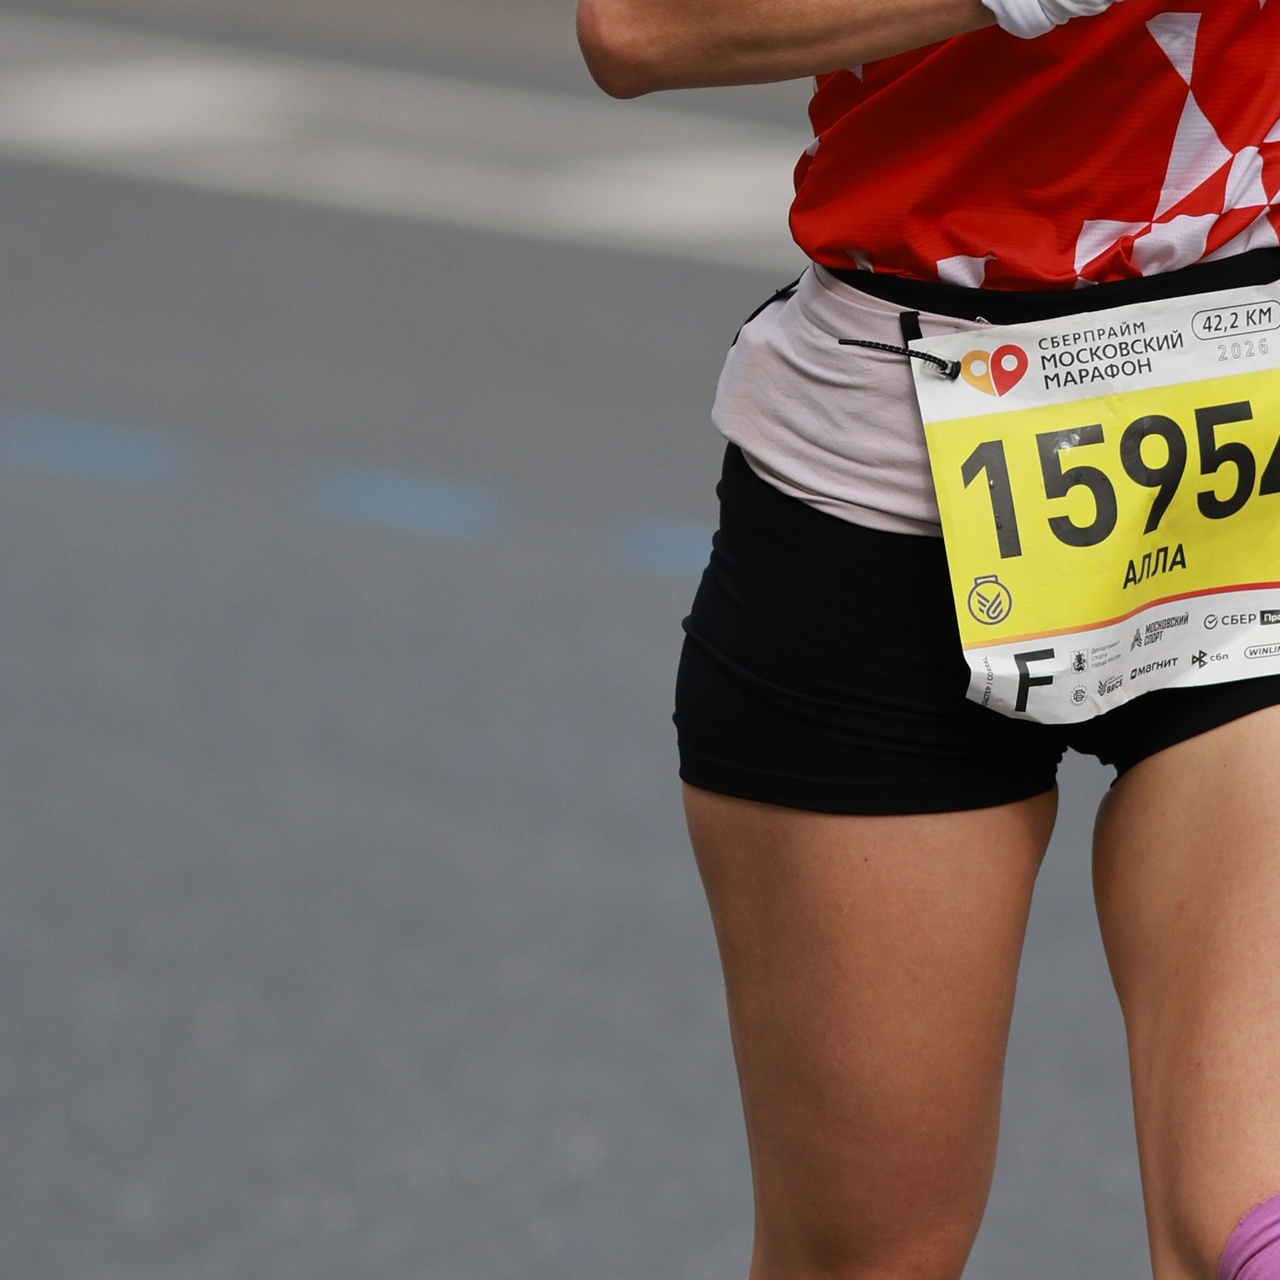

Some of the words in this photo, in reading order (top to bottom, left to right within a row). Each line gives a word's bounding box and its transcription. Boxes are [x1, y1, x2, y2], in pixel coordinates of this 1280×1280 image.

[1201, 311, 1240, 334] 42,2
[1245, 306, 1273, 326] КМ
[1038, 321, 1147, 351] СБЕРПРАЙМ
[1040, 329, 1184, 371] МОСКОВСКИЙ
[1217, 337, 1270, 362] 2026
[1043, 357, 1153, 391] МАРАФОН
[1122, 542, 1188, 590] АЛЛА
[1144, 612, 1190, 634] МОСКОВСКИЙ
[1221, 613, 1257, 626] СБЕР
[1143, 630, 1164, 646] СПОРТ
[1013, 648, 1056, 713] F
